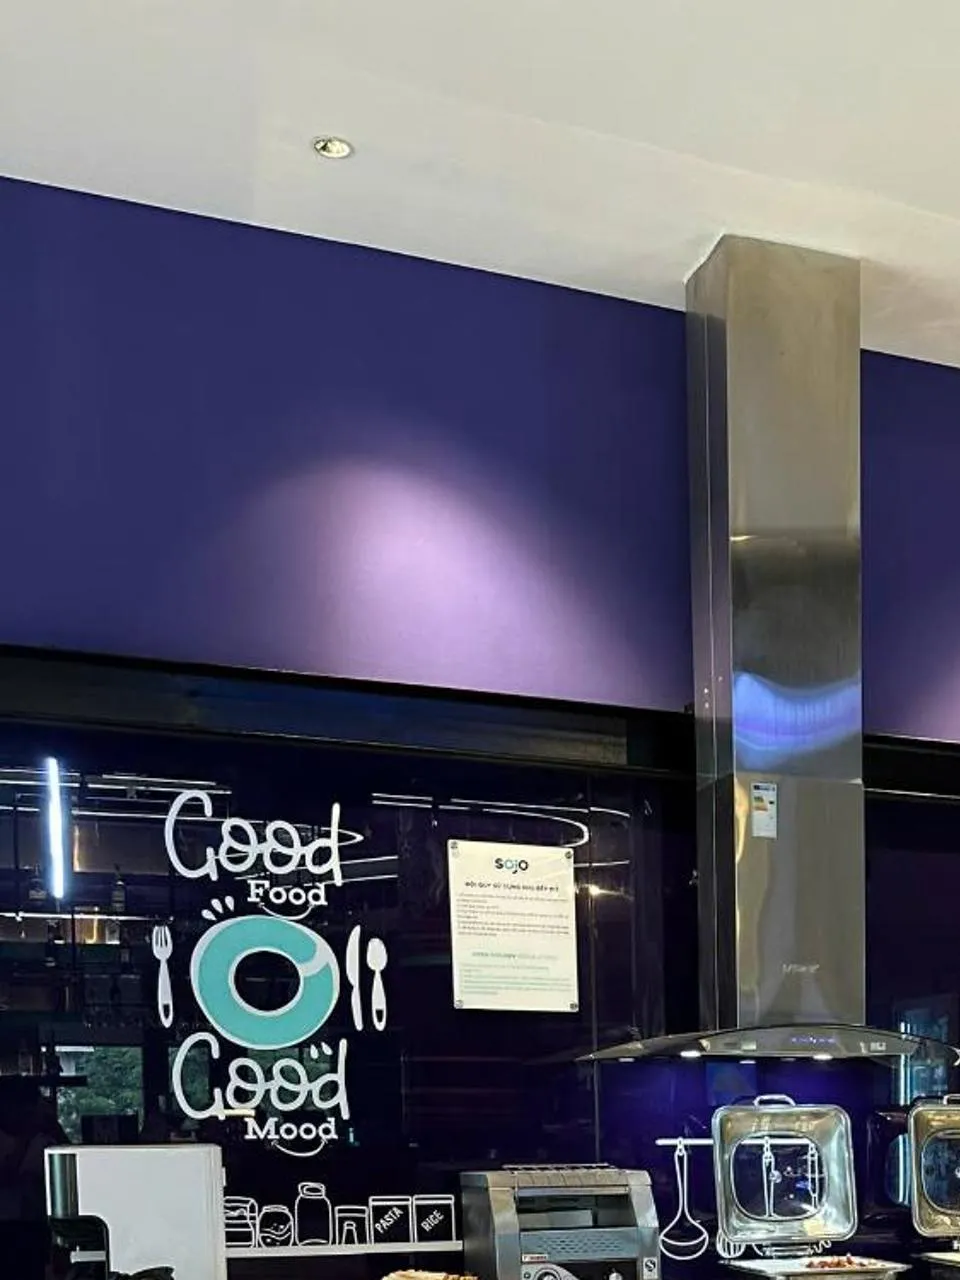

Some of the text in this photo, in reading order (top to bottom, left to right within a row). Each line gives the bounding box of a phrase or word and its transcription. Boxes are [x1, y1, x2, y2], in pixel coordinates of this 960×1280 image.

[164, 789, 342, 887] Good
[247, 879, 328, 906] Food
[172, 1031, 350, 1120] Good
[244, 1117, 338, 1140] Mood
[374, 1206, 404, 1234] PASTA
[421, 1209, 445, 1232] RICE
